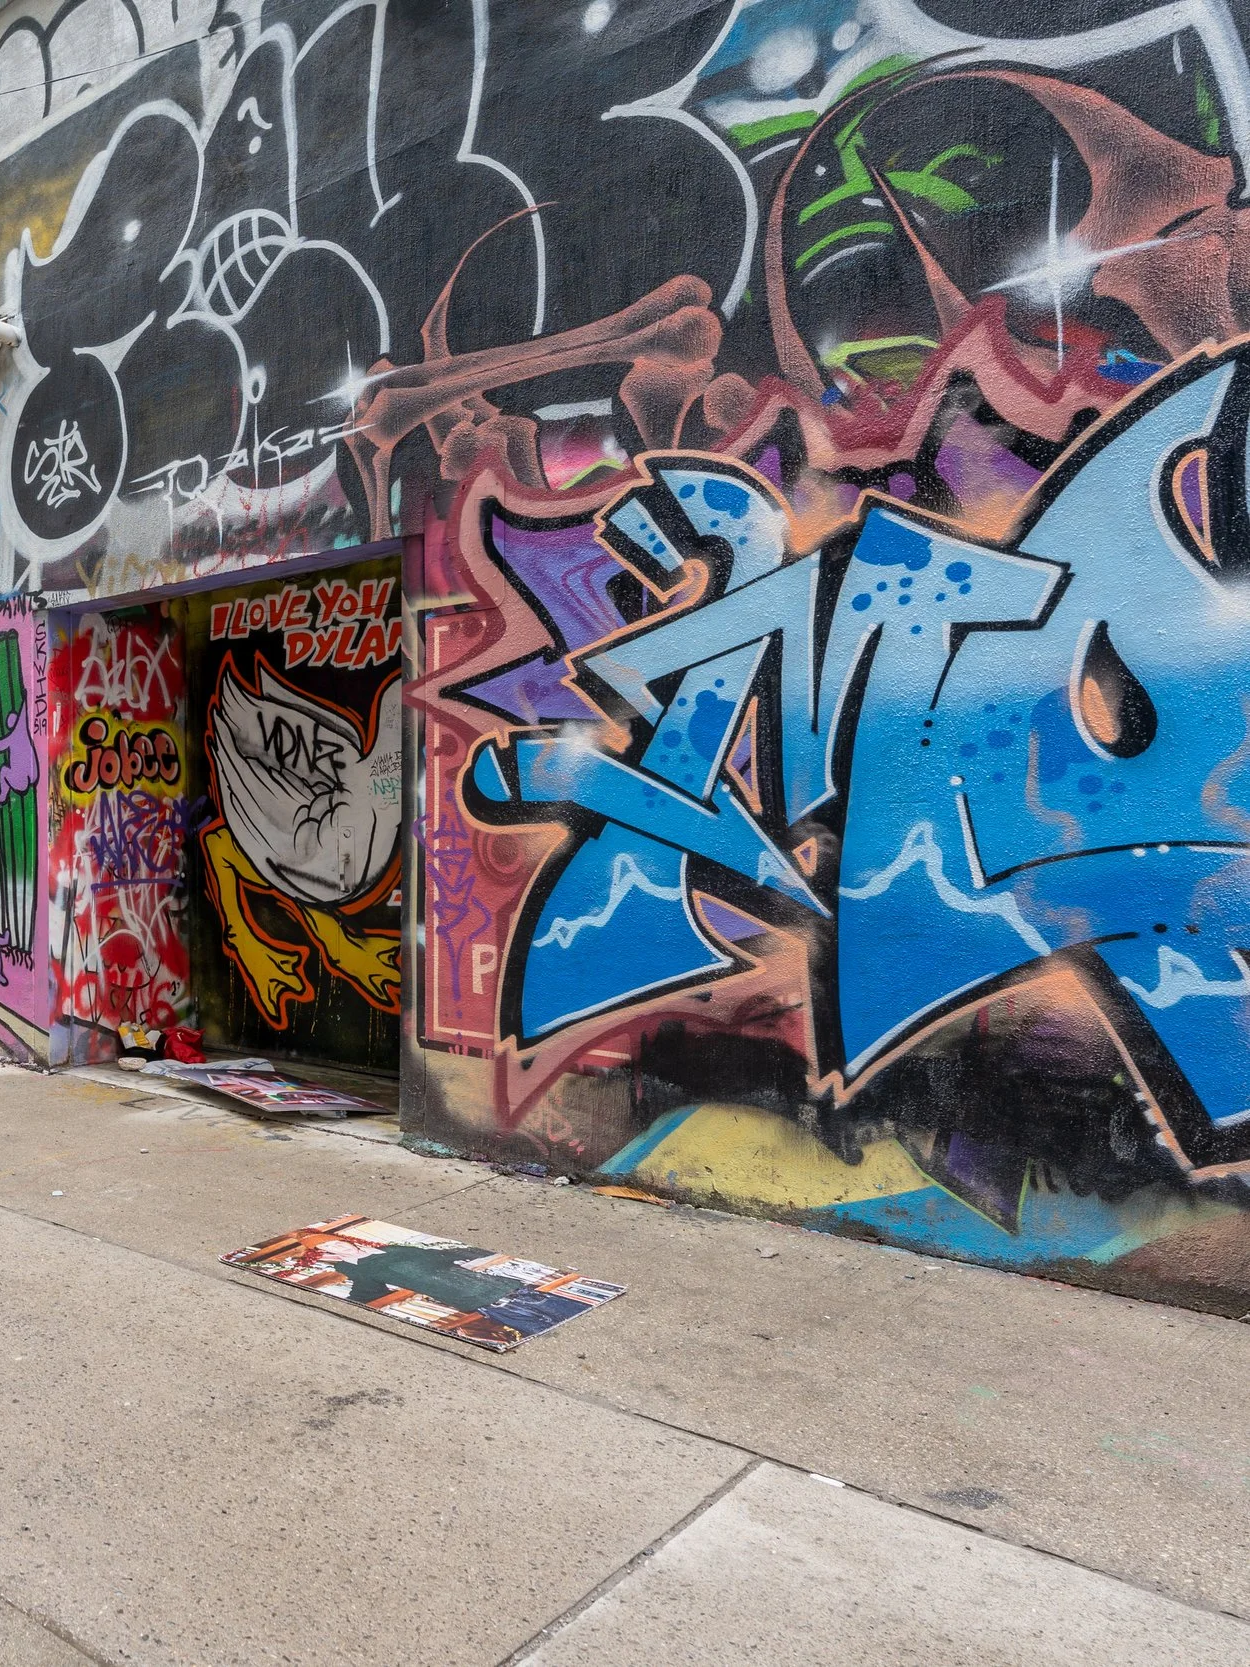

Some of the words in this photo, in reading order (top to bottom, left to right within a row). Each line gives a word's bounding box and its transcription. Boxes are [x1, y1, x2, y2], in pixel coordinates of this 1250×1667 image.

[210, 602, 233, 641] I
[228, 584, 315, 640] LOVE
[313, 577, 396, 628] YOU
